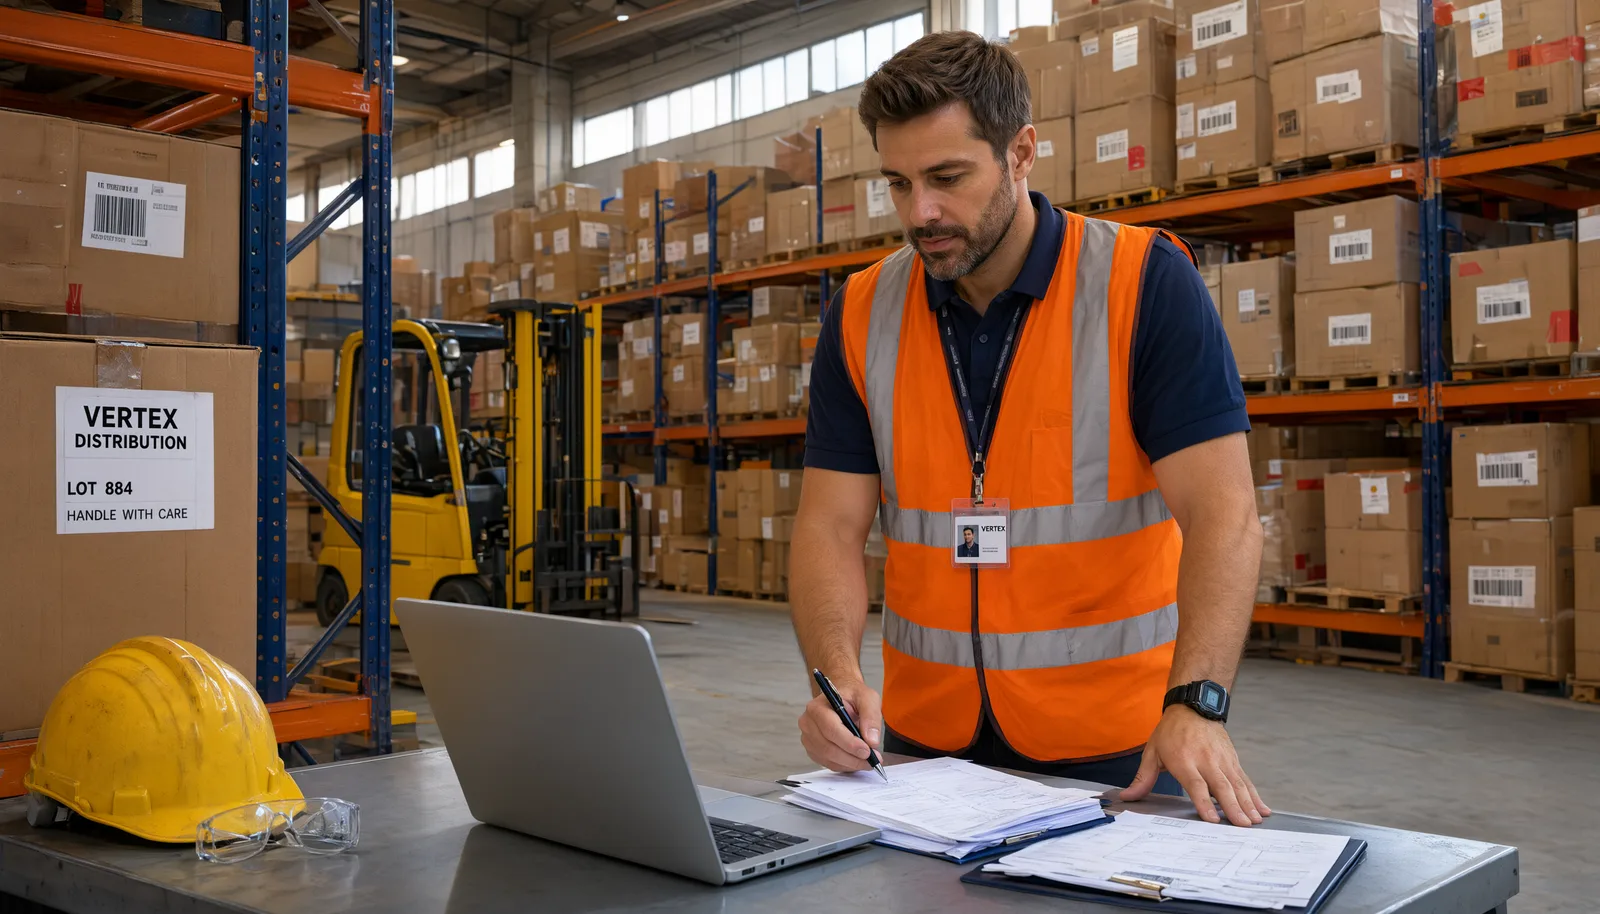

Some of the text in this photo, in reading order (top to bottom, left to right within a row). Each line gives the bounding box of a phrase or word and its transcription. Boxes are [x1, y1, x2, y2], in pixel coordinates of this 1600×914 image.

[83, 405, 178, 429] VERTEX
[75, 433, 187, 450] DISTRIBUTION
[67, 481, 133, 496] LOT 884
[67, 508, 188, 521] HANDLE WITH CARE
